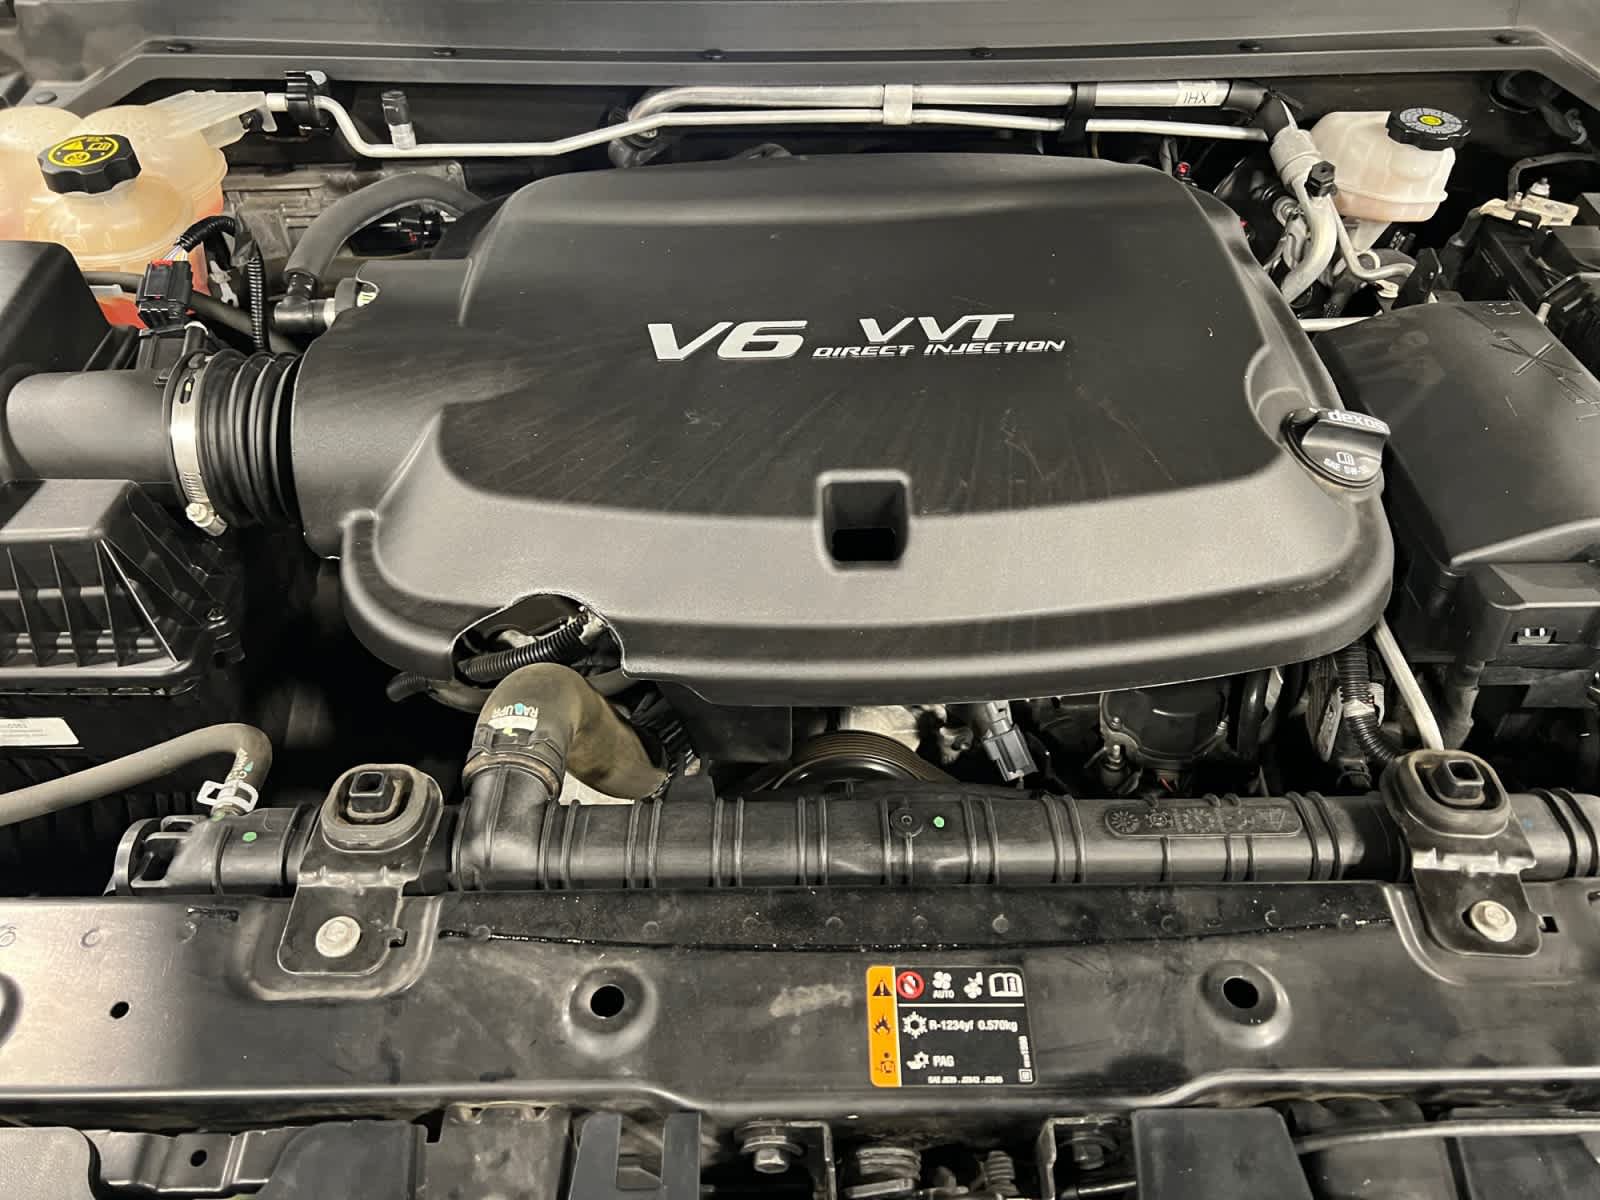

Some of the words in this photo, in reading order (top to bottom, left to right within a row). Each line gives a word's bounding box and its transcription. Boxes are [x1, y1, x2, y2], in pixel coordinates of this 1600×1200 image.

[859, 313, 1015, 343] VVT
[647, 320, 808, 361] V6
[812, 344, 915, 358] DIRECT
[923, 340, 1066, 355] INJECTION
[932, 989, 955, 999] AUTO
[977, 1019, 1018, 1032] 0.570kg
[932, 1055, 955, 1067] PAG
